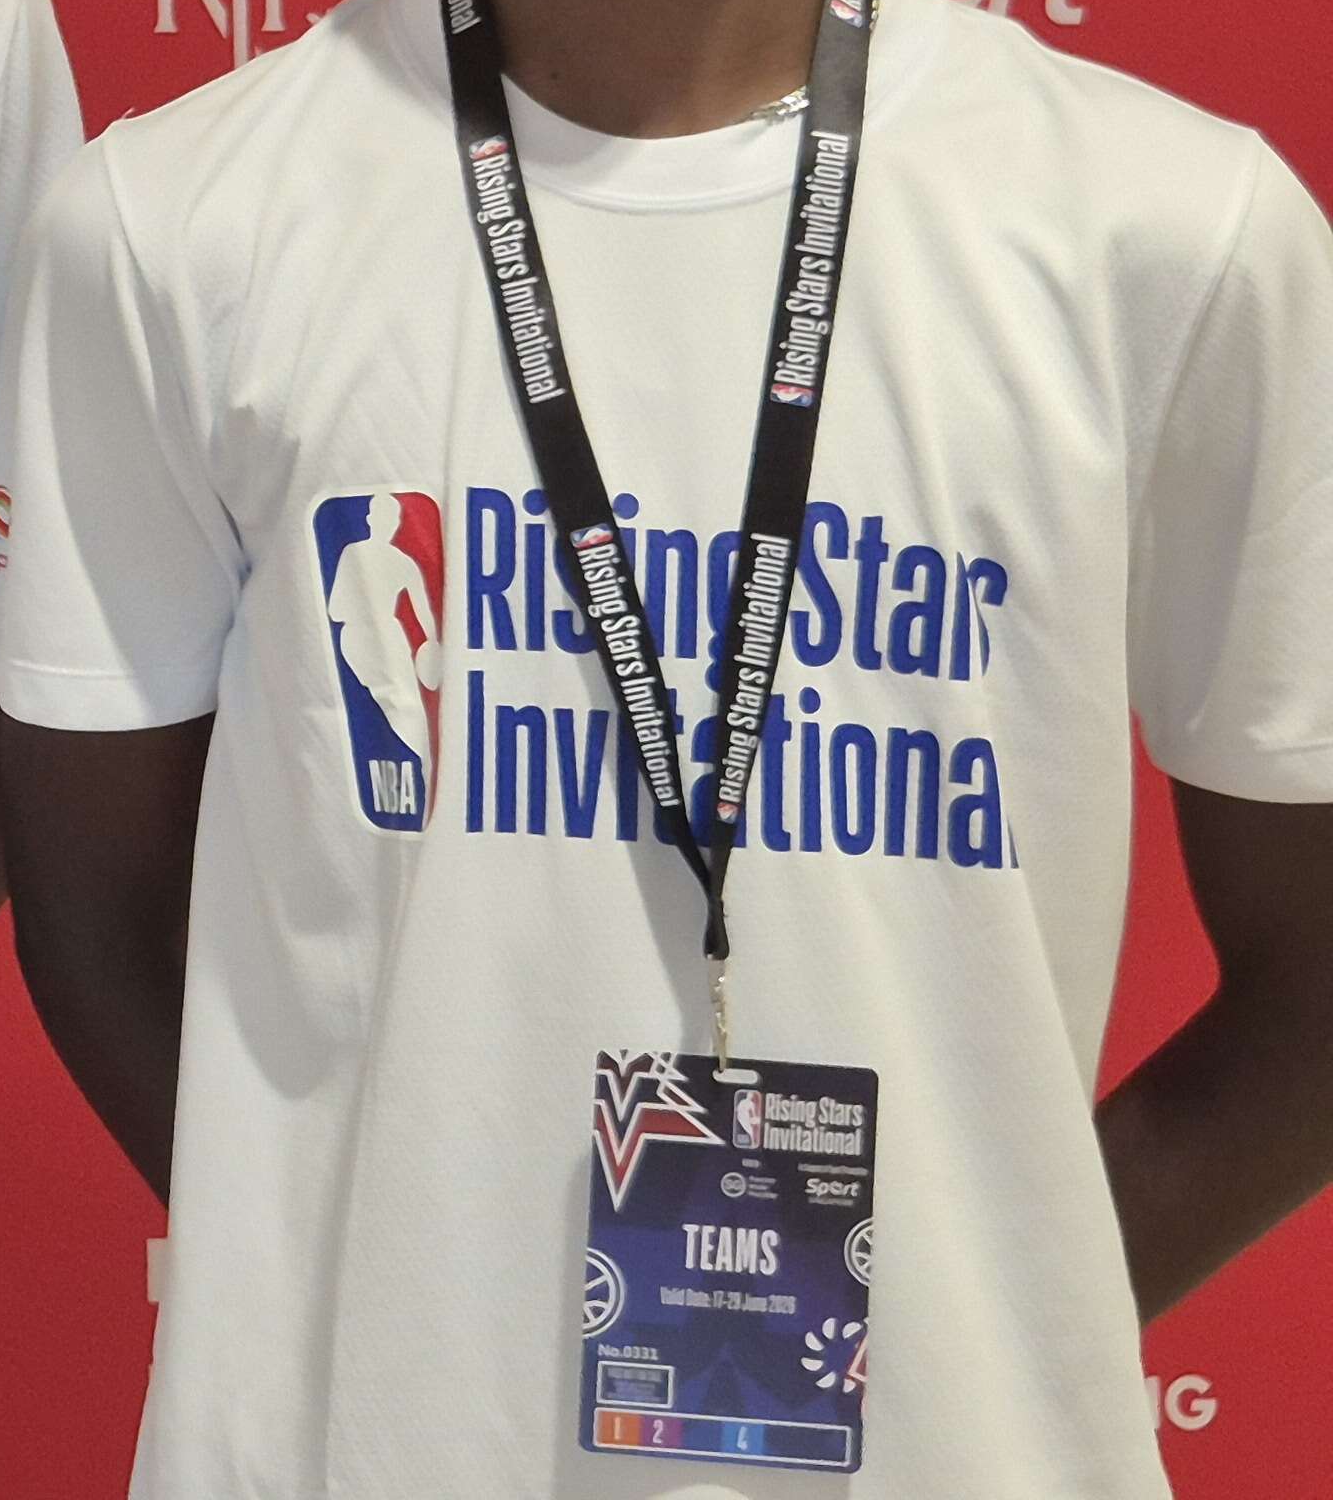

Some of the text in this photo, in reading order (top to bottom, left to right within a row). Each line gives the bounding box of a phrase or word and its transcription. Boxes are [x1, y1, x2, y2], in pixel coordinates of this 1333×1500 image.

[472, 153, 566, 404] Rising Stars Invitational
[774, 130, 849, 387] Rising Stars Invitational
[577, 543, 682, 808] Rising Stars Invitational
[718, 532, 791, 803] Rising Stars Invitational
[369, 760, 417, 814] NBA
[765, 1093, 864, 1128] Rising Stars
[763, 1122, 862, 1156] Invitational
[682, 1224, 779, 1276] TEAMS
[613, 1416, 621, 1440] 1
[652, 1419, 664, 1444] 2
